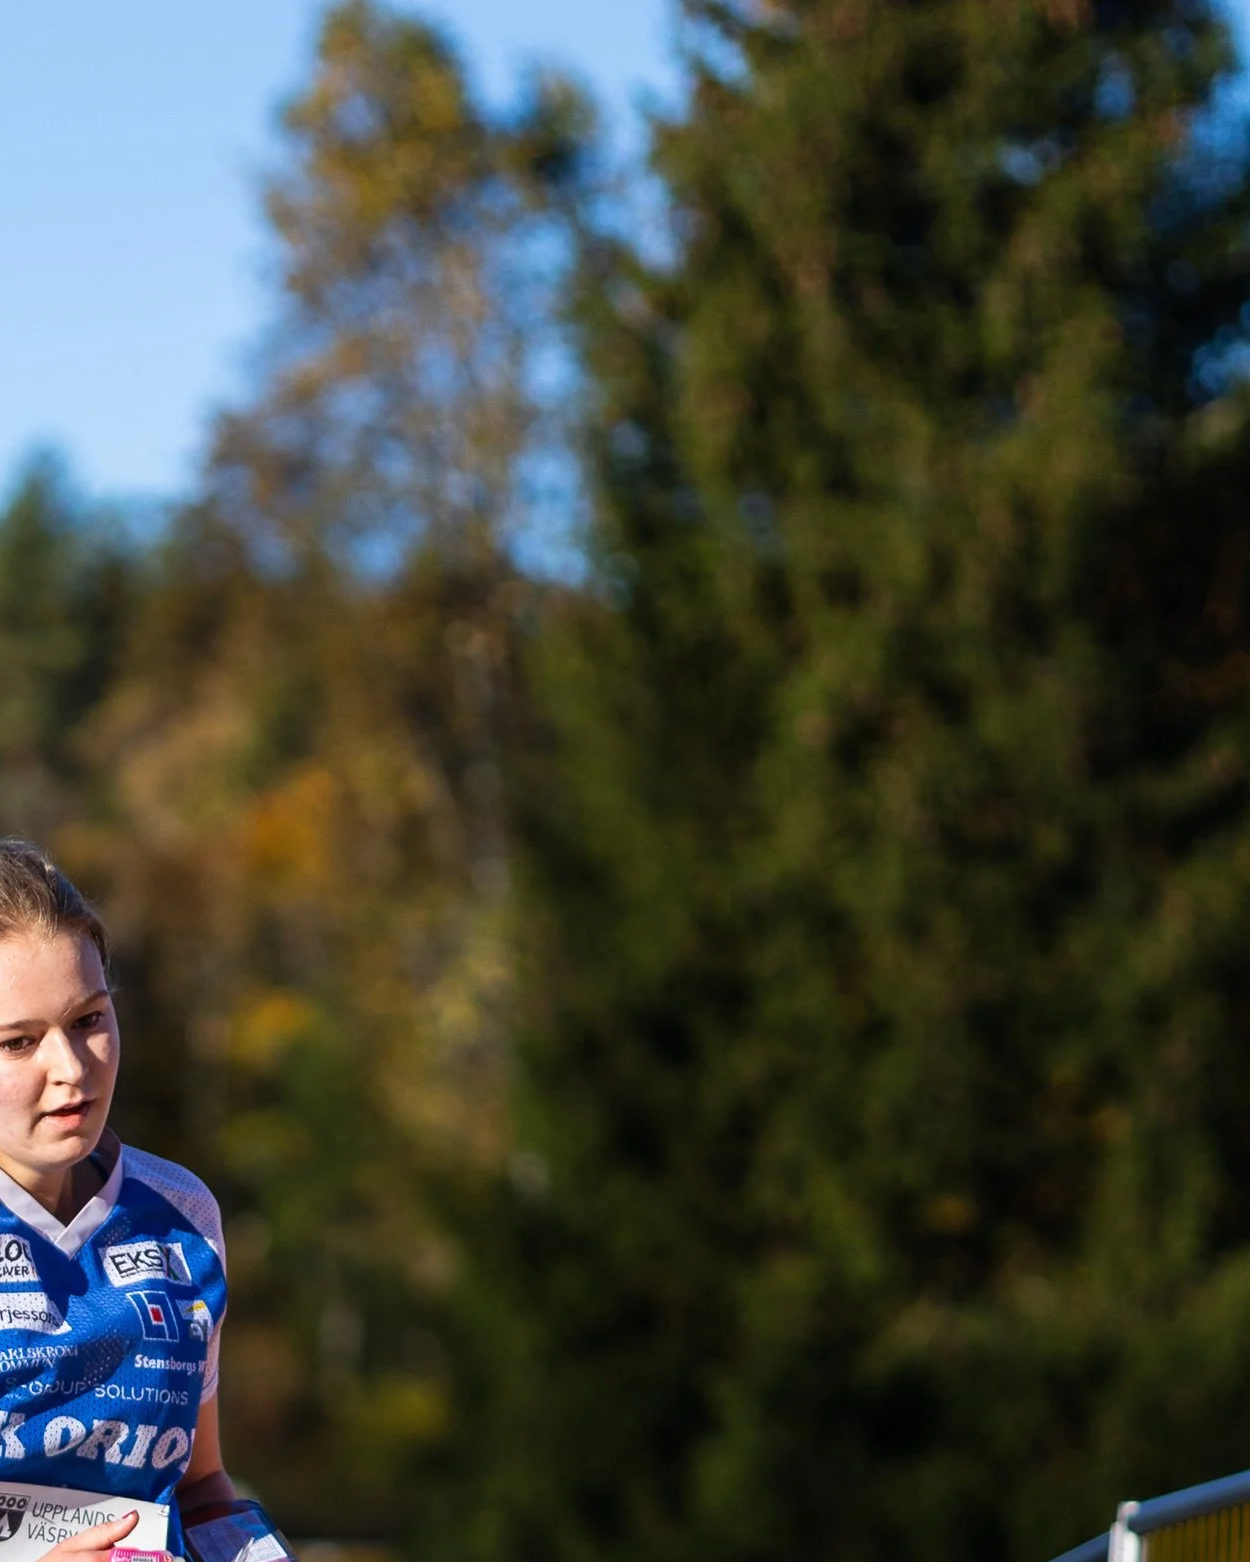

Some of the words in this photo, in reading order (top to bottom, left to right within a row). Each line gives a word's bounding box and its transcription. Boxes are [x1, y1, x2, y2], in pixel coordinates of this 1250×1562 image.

[134, 1354, 196, 1376] Stensborgs
[94, 1384, 190, 1406] SOLUTIONS
[32, 1502, 116, 1528] UPPLANDS
